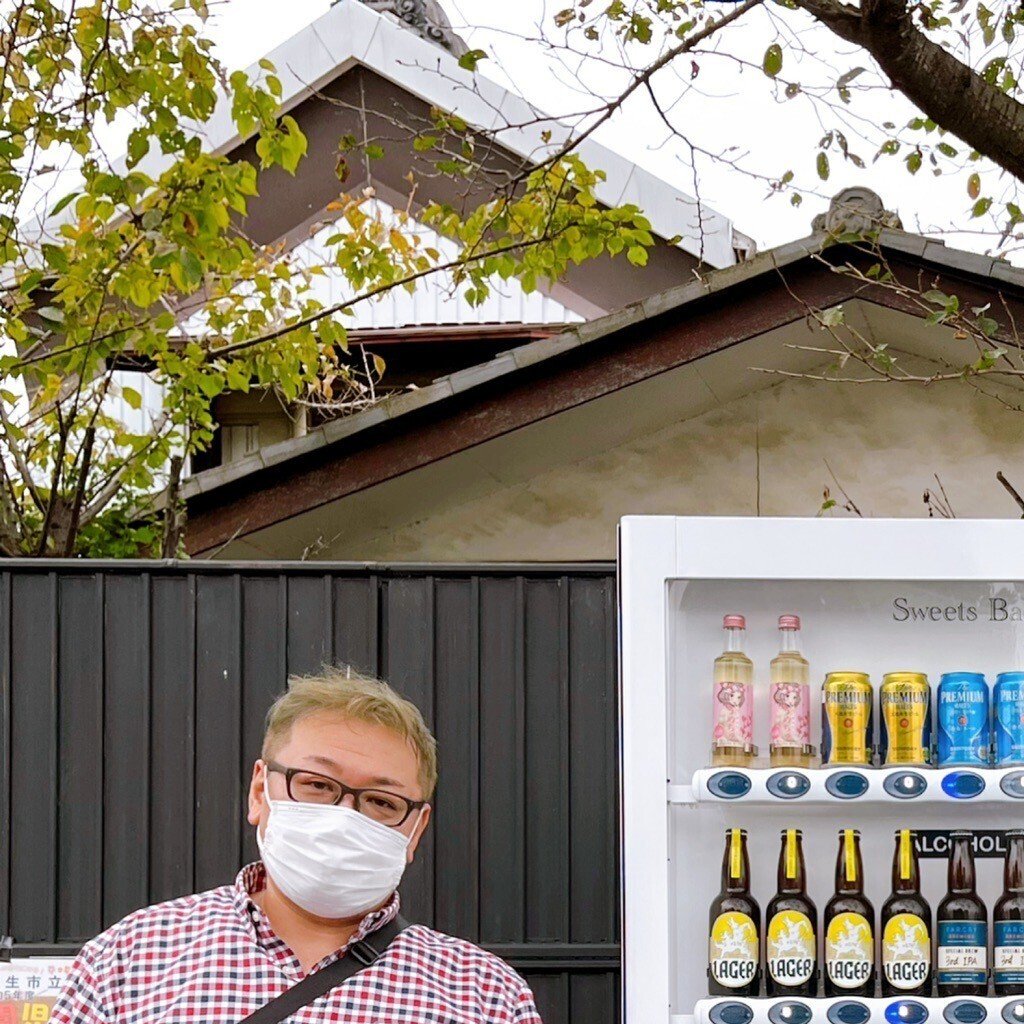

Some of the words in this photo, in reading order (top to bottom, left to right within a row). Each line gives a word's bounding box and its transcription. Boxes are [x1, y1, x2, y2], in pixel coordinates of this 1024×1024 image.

[893, 597, 978, 622] Sweets
[941, 691, 984, 703] PREMIUM
[915, 836, 1007, 852] LCHOL
[713, 960, 754, 979] LAGER
[770, 959, 811, 978] LAGER
[829, 960, 868, 980] LAGER
[963, 956, 978, 965] IPA
[886, 962, 926, 981] LAGER
[5, 975, 61, 989] 生市立
